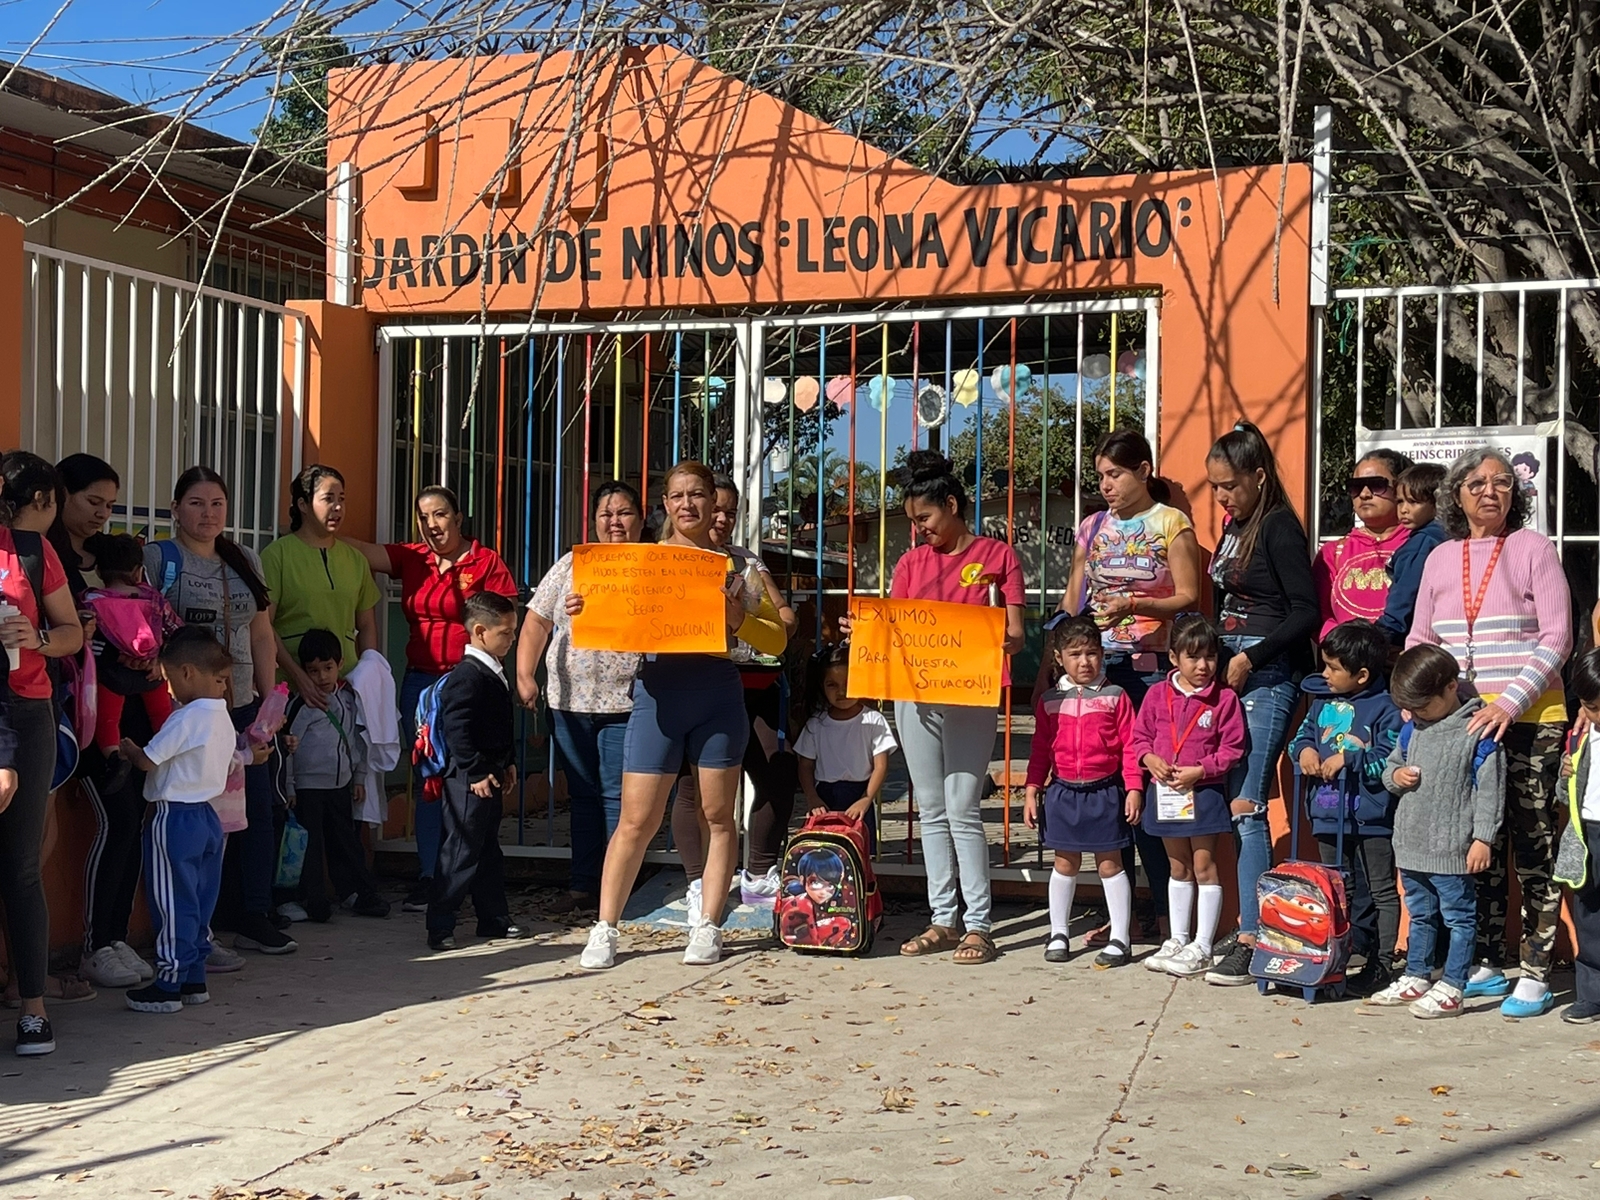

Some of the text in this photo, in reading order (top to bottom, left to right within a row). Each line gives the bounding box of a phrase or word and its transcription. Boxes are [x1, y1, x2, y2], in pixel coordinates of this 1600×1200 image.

[545, 229, 601, 283] DE
[623, 210, 765, 280] NIÑOS
[1047, 525, 1075, 546] LEO
[622, 567, 656, 577] ESTEN
[661, 567, 676, 577] EN
[188, 580, 214, 590] LOVE
[858, 600, 937, 626] EXIJIMOS
[893, 627, 963, 649] SOLUCION
[858, 646, 959, 669] PARA NUESTRA
